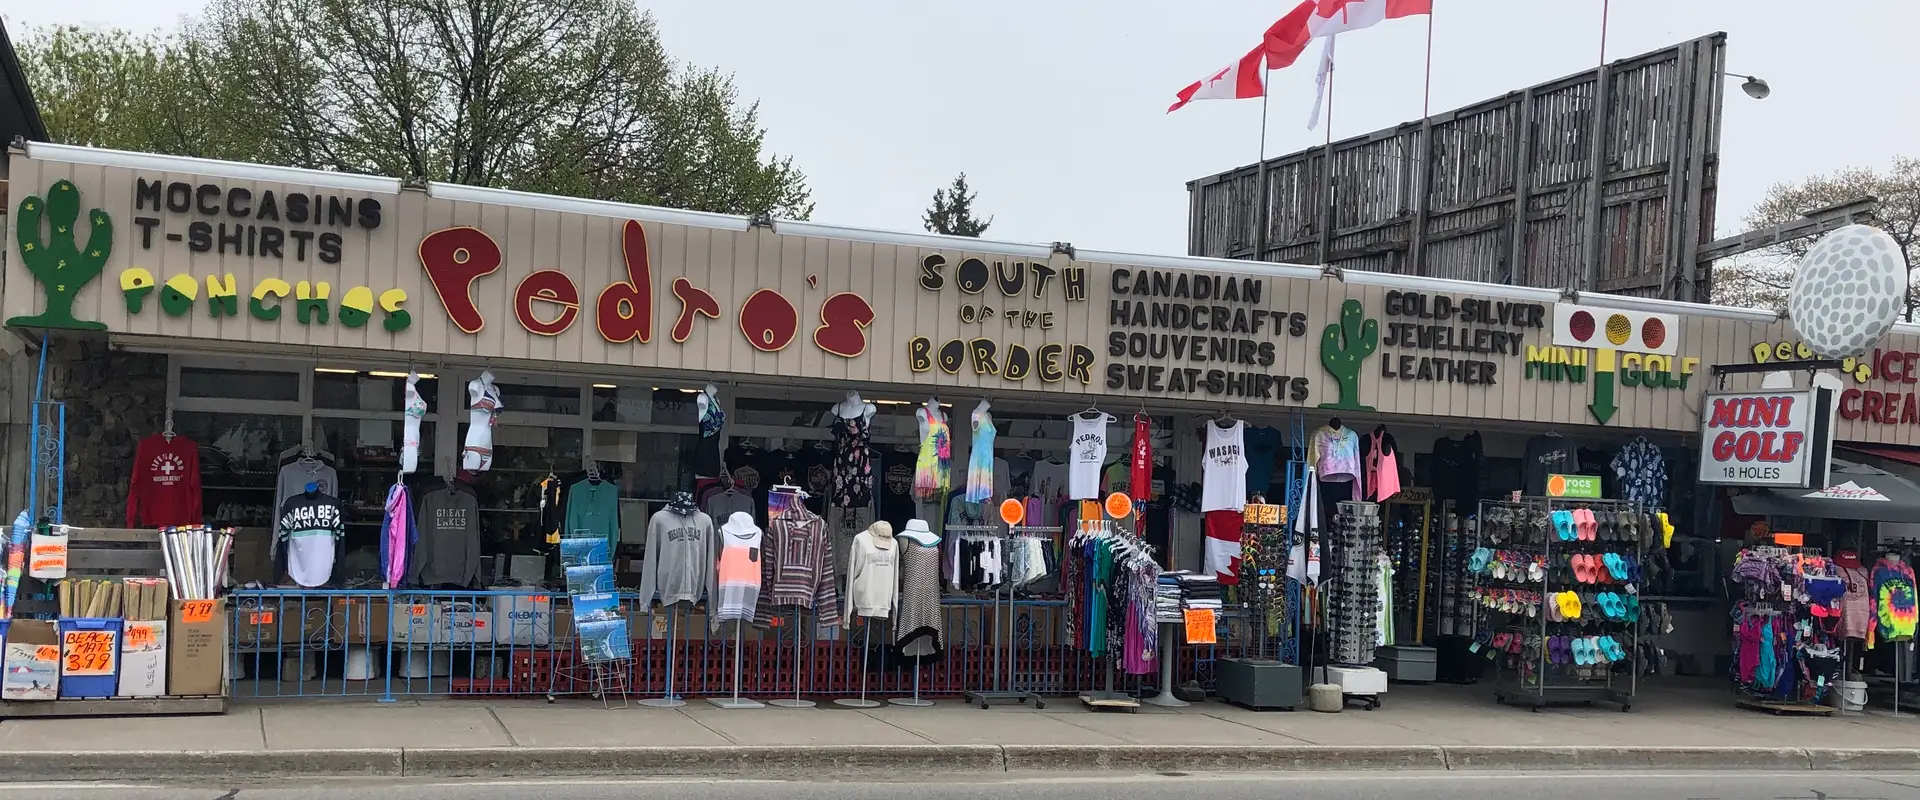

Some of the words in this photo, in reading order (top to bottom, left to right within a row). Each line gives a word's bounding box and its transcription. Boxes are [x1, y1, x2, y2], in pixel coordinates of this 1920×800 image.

[136, 176, 382, 230] MOCCASINS
[135, 216, 343, 264] T-SHIRTS
[418, 219, 876, 357] Pedro's
[919, 252, 1087, 301] SOUTH
[1111, 268, 1263, 305] CANADIAN
[119, 267, 412, 332] PONCHOS
[960, 303, 995, 323] OF
[1003, 308, 1055, 330] THE
[1385, 290, 1546, 329] GOLD-SILVER
[1110, 299, 1308, 338] HANDCRAFTS
[1108, 331, 1277, 367] SOUVENIRS
[1382, 321, 1524, 356] JEWELLERY
[908, 335, 1096, 384] BORDER
[1381, 354, 1498, 386] LEATHER
[1525, 344, 1588, 384] MINI
[1620, 352, 1700, 391] GOLF
[1872, 348, 1920, 385] ICE
[1106, 363, 1310, 401] SWEAT-SHIRTS
[1708, 396, 1795, 428] MINI
[1838, 388, 1920, 425] CREA
[1075, 433, 1104, 446] PEDROS
[1711, 431, 1804, 463] GOLF
[1566, 479, 1592, 488] rocs
[1722, 467, 1735, 479] 18
[1738, 467, 1780, 479] HOLES
[436, 508, 467, 518] GREAT
[436, 517, 467, 527] LAKES
[66, 632, 115, 645] BEACH
[74, 642, 114, 655] MATS
